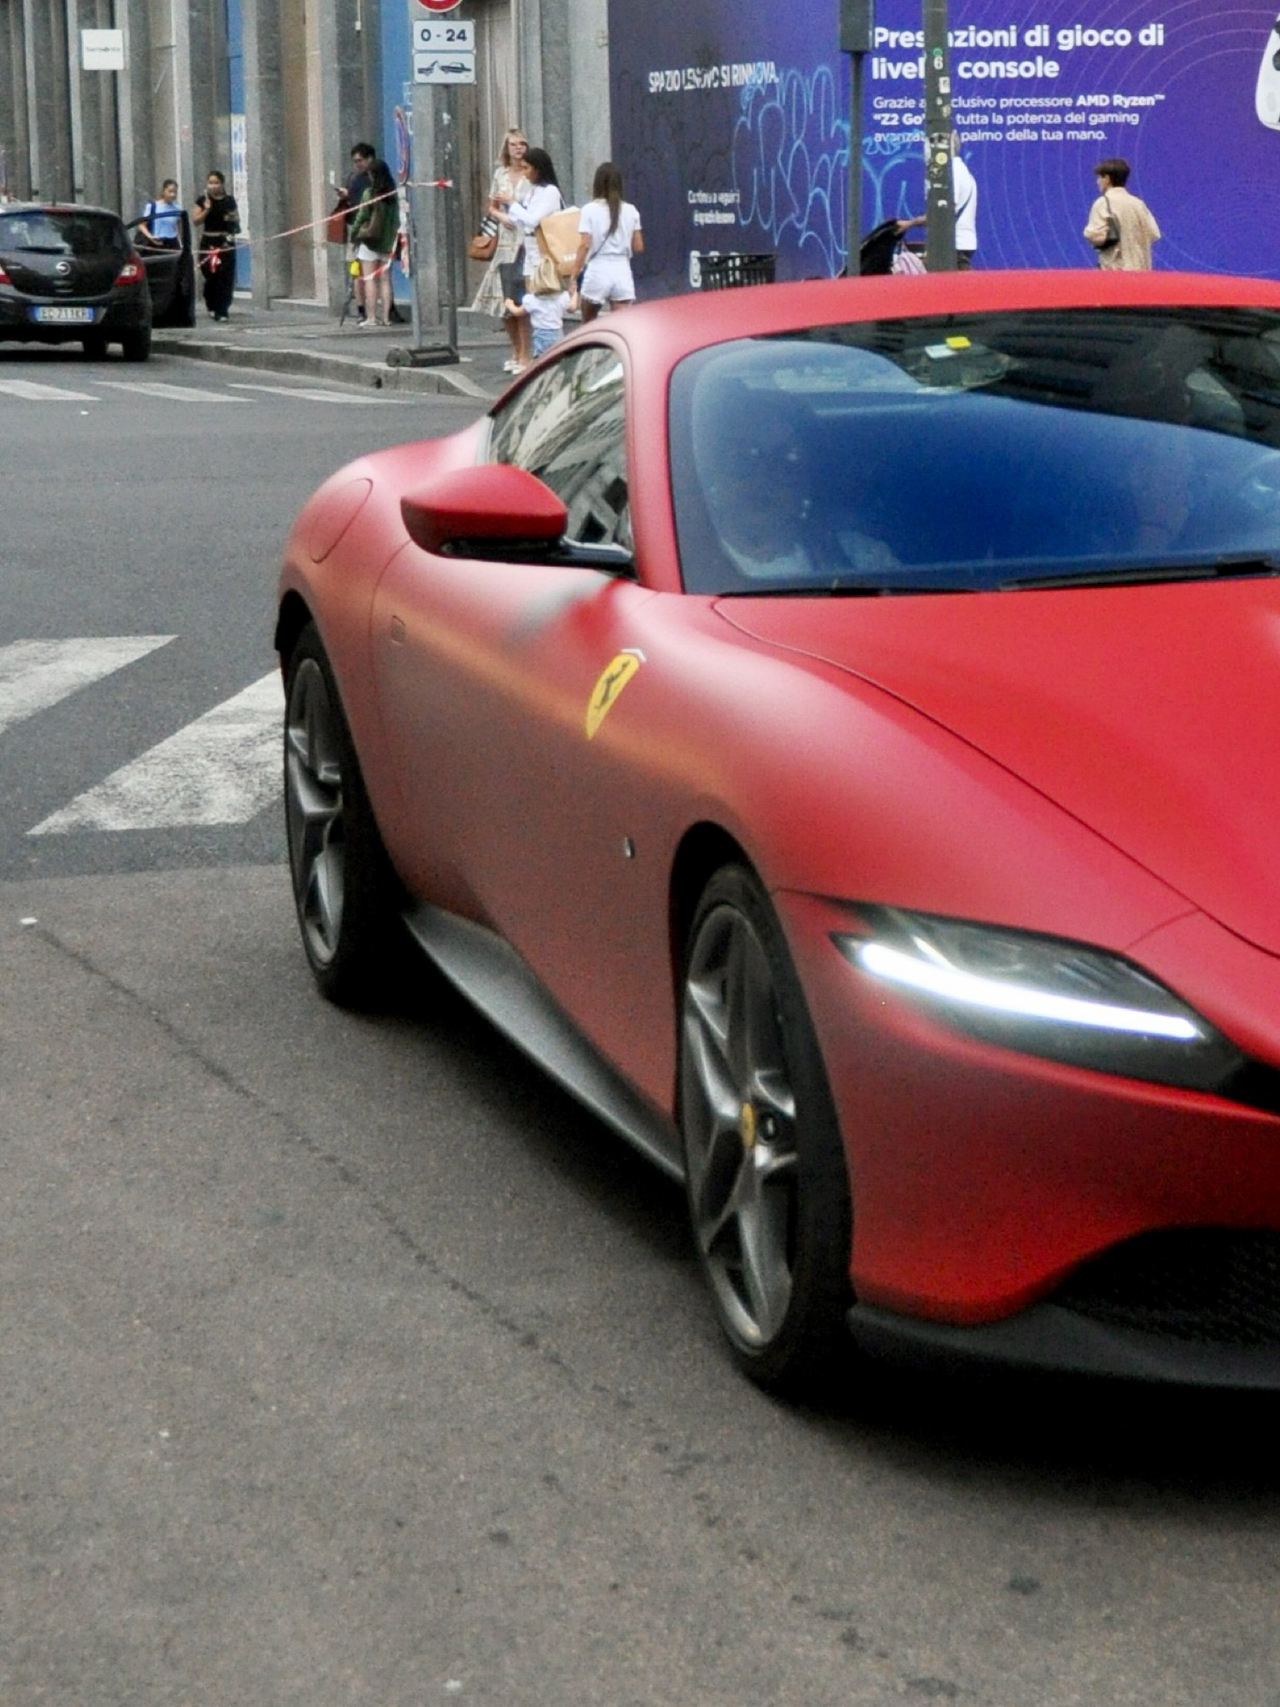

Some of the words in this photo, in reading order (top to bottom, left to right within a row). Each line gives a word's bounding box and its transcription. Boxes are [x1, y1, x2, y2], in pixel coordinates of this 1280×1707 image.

[421, 28, 432, 42] 0
[446, 28, 467, 42] 24
[1024, 24, 1050, 47] di
[1057, 24, 1132, 50] gioco
[1138, 23, 1164, 46] di
[957, 55, 1060, 79] console
[873, 96, 916, 109] Grazie
[999, 95, 1073, 109] processore
[1076, 94, 1110, 107] AMD
[955, 113, 989, 125] tutta
[992, 113, 1003, 124] la
[1006, 113, 1062, 127] potenza
[1064, 112, 1086, 124] del
[1089, 112, 1139, 126] gaming
[961, 129, 1003, 143] palmo
[1006, 128, 1039, 141] della
[1042, 129, 1064, 141] tua
